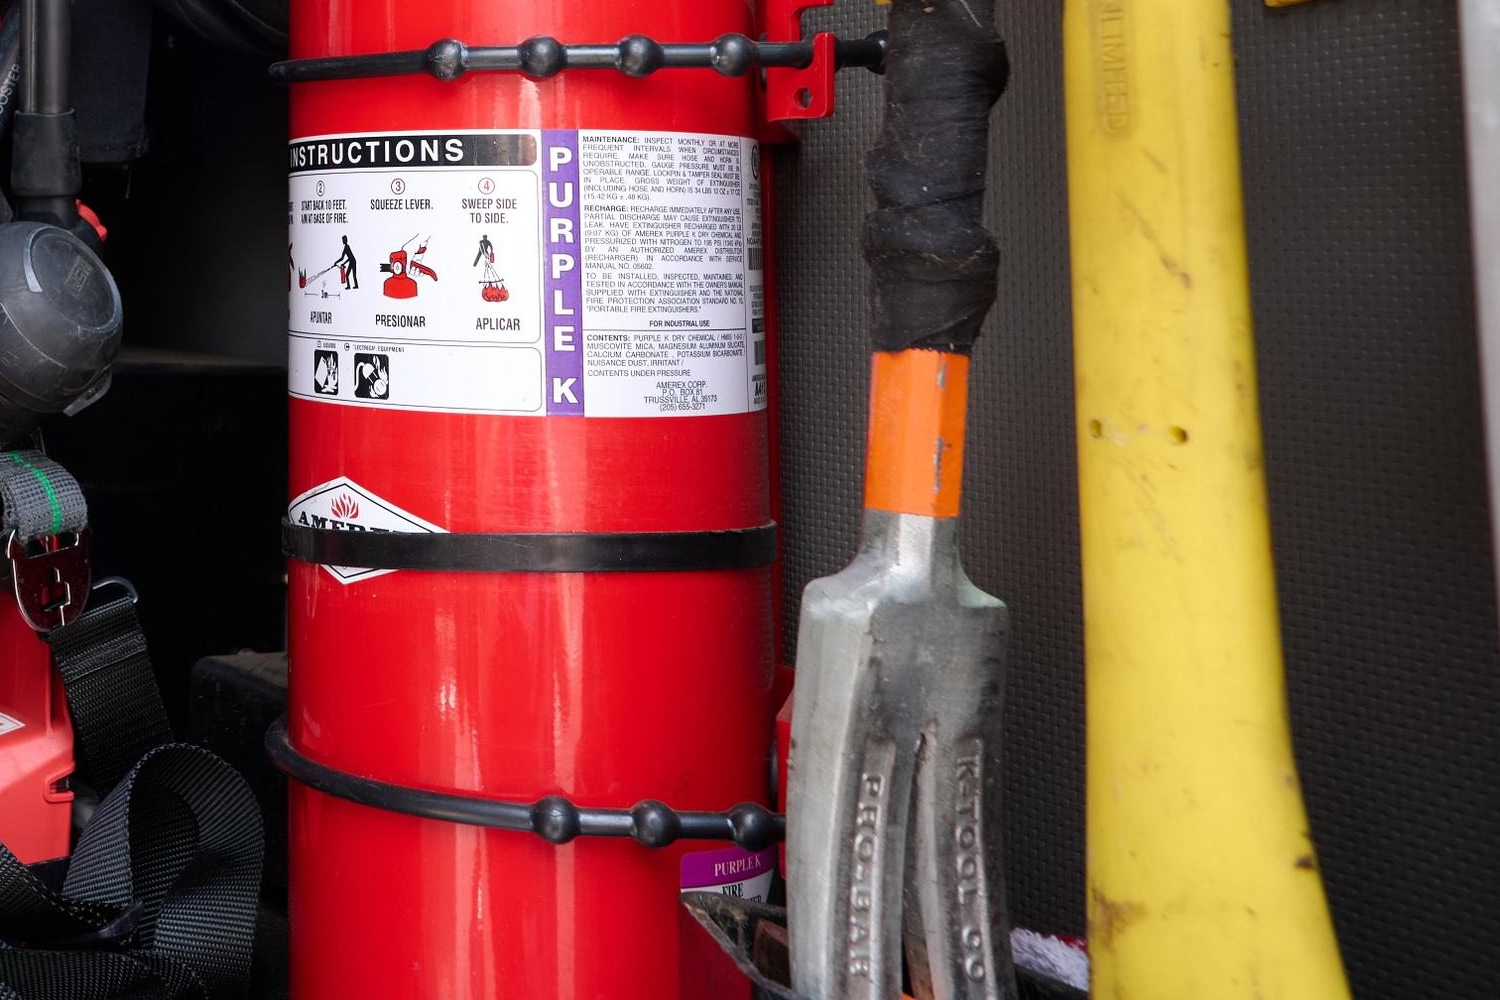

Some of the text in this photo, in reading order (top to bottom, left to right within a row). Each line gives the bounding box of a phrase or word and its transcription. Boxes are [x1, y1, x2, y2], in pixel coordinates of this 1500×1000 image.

[582, 136, 639, 144] MAINTENANCE:
[644, 137, 673, 145] INSPECT
[290, 138, 464, 168] INSTRUCTIONS
[633, 145, 671, 153] INTERVALS
[666, 178, 691, 186] WEIGHT
[584, 185, 627, 193] (INCLUDING
[332, 200, 347, 210] FEET.
[370, 198, 434, 210] SQUEEZE LEVER.
[461, 198, 517, 209] SWEEP SIDE
[326, 213, 333, 224] OF
[334, 212, 348, 224] FIRE.
[470, 212, 509, 224] TO SIDE.
[549, 145, 576, 353] PURPLE
[585, 254, 639, 262] (RECHARGER)
[310, 311, 333, 324] APUNTAR
[375, 314, 426, 328] PRESIONAR
[476, 317, 521, 331] APLICAR
[552, 377, 580, 405] K
[660, 404, 677, 412] (205)
[956, 755, 981, 905] K-TOOL
[714, 855, 762, 877] PURPLE K
[850, 773, 885, 977] PRO-BAR
[722, 882, 743, 897] FIRE
